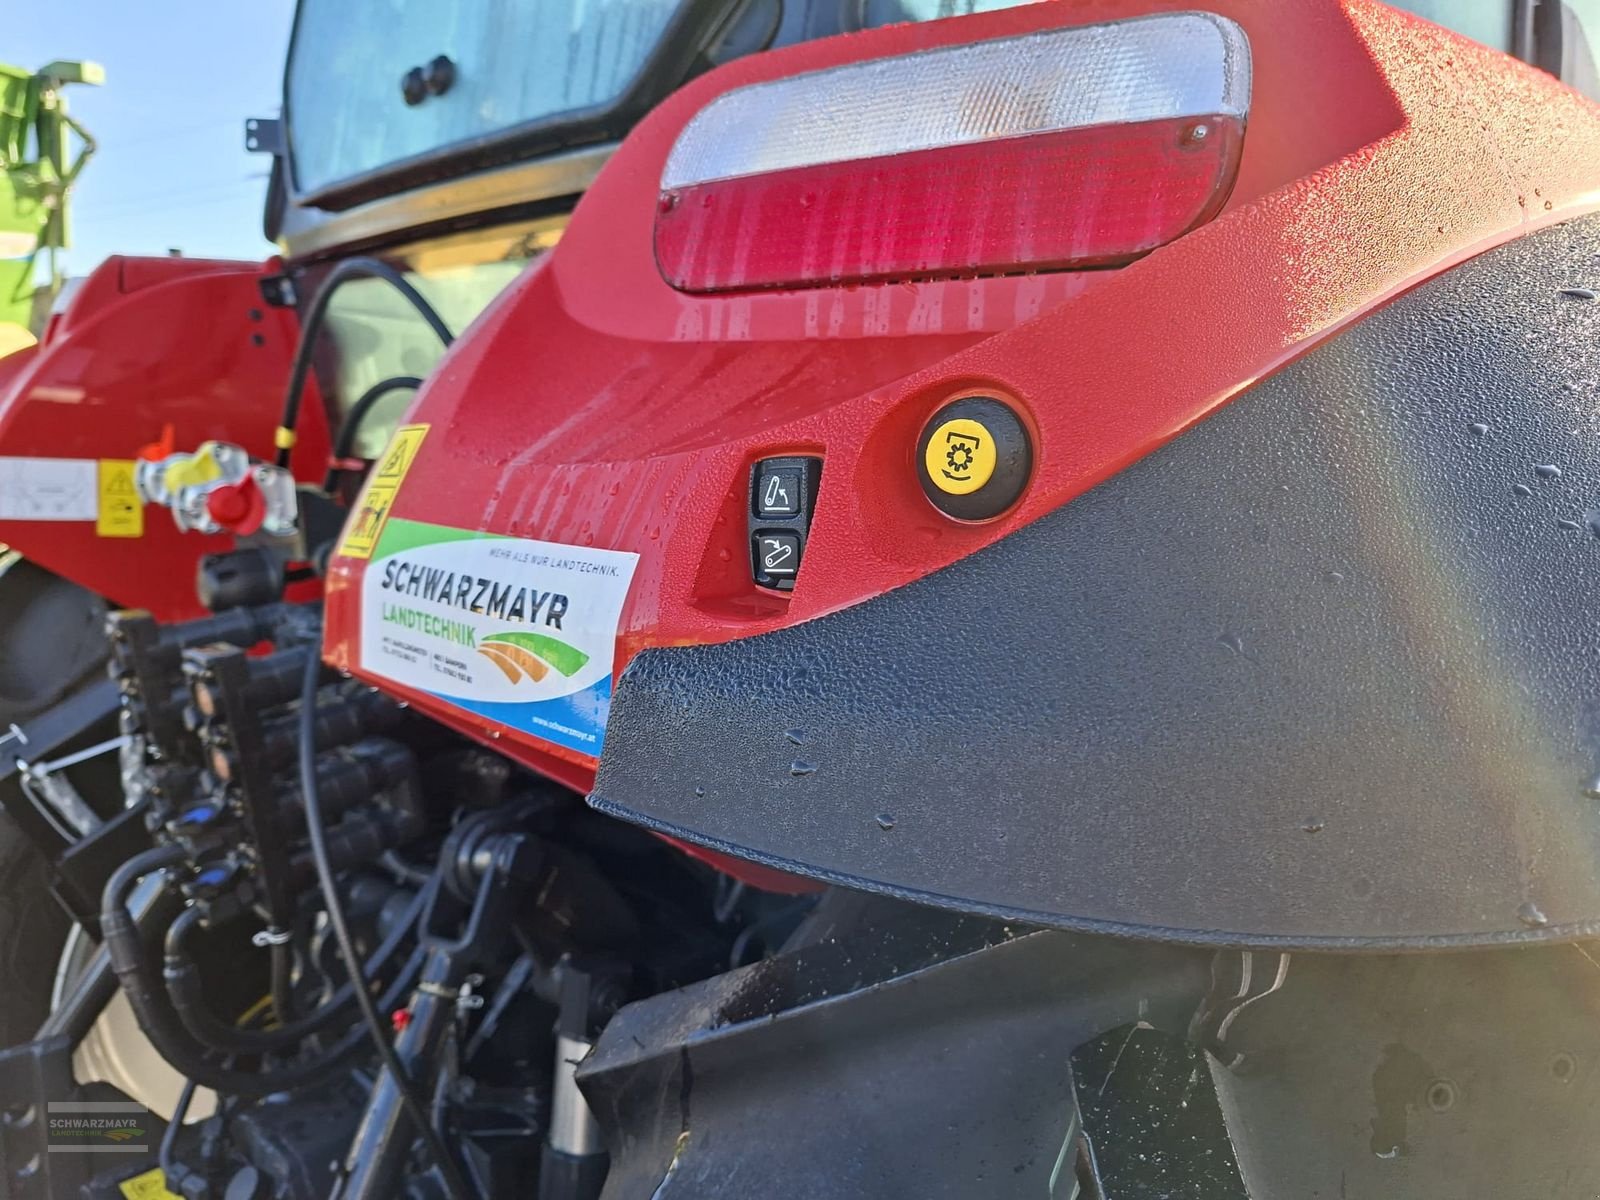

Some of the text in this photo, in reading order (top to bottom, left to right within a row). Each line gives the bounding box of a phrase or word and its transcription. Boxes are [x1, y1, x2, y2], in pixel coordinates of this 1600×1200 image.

[489, 548, 620, 577] MEHR ALS NUR LANDTECHNIK.
[381, 559, 569, 631] SCHWARZMAYR
[382, 602, 477, 649] LANDTECHNIK
[531, 716, 596, 743] www.schwarzmayr.at
